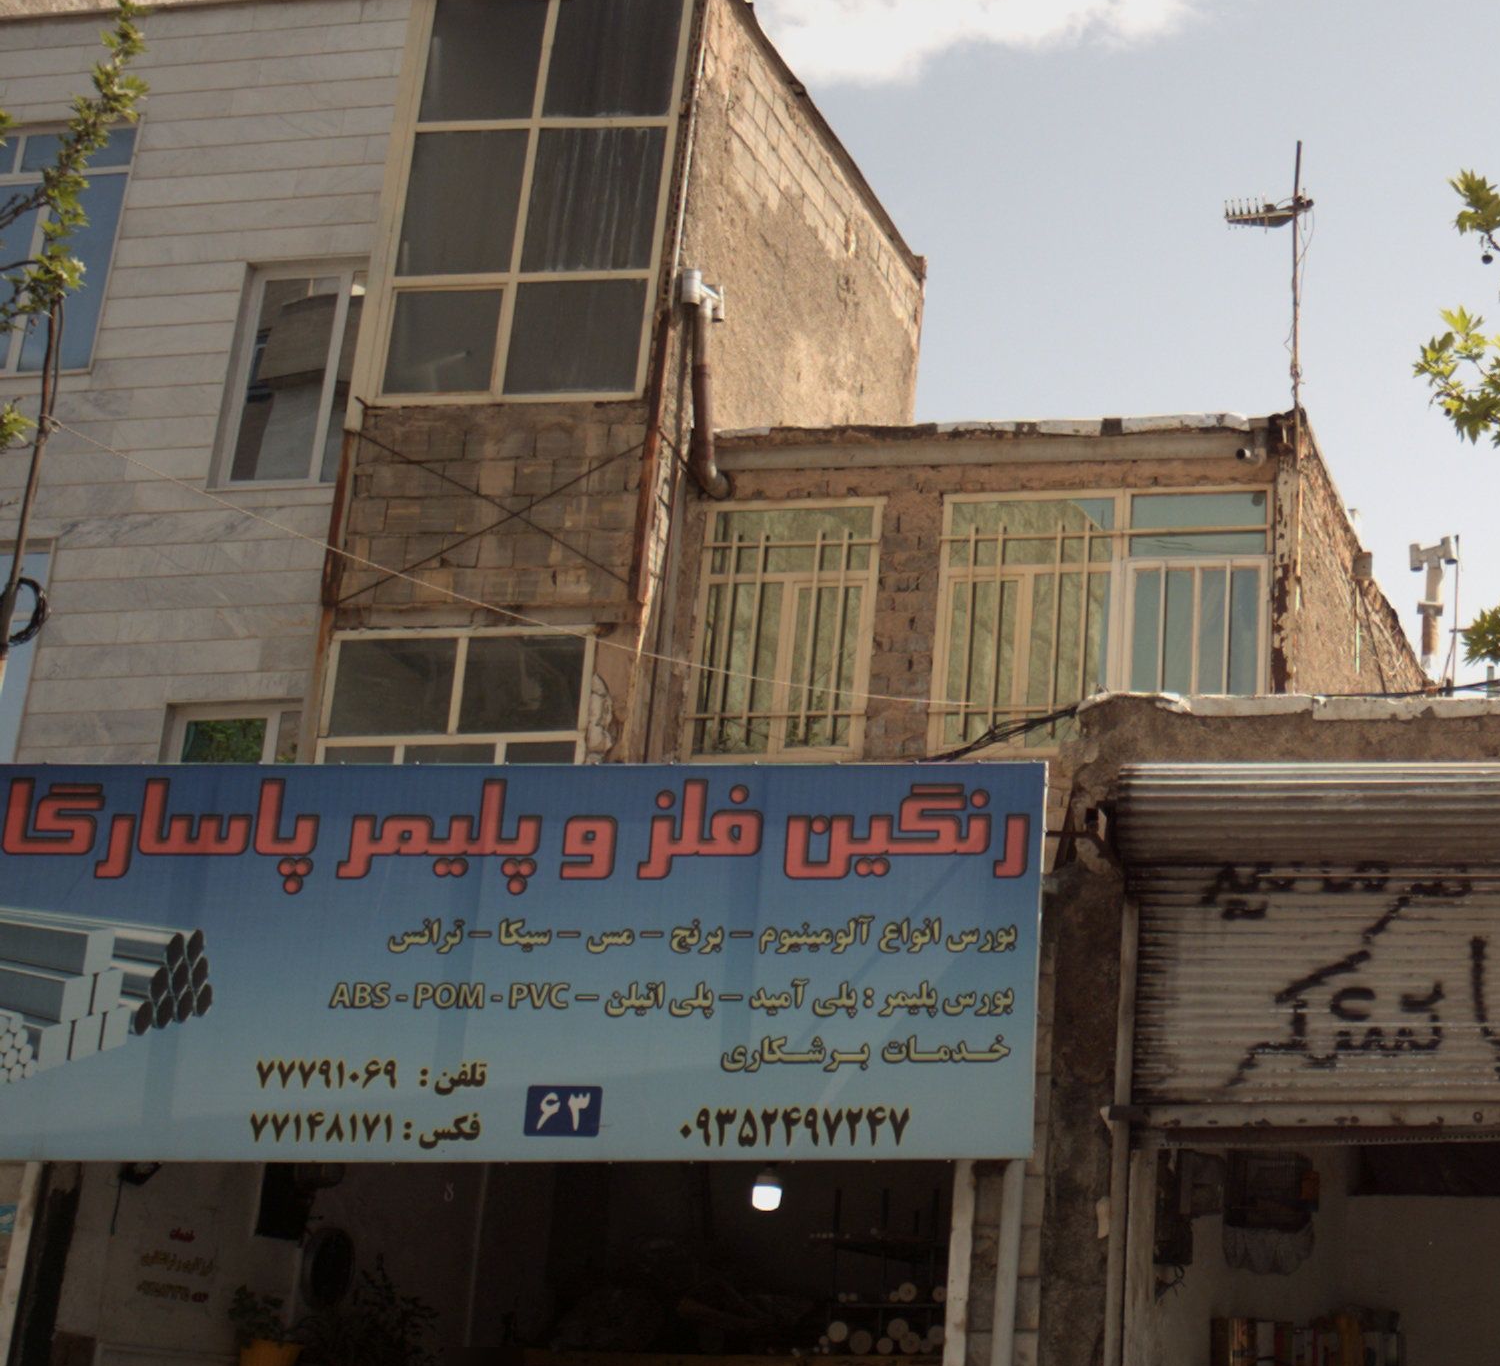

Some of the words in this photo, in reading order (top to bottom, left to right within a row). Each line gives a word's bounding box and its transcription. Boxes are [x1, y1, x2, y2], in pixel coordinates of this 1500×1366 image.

[336, 778, 543, 895] پلیمر
[637, 778, 764, 880] فلز
[783, 783, 1031, 880] رنگین
[559, 815, 619, 880] و
[388, 919, 464, 954] ترانس
[498, 919, 550, 953] سیکا
[586, 927, 634, 954] مس
[671, 921, 725, 955] برنج
[759, 915, 875, 953] آلومینیوم
[878, 917, 942, 953] انواع
[946, 921, 1018, 953] بورس
[329, 983, 390, 1009] ABS
[413, 983, 486, 1009] POM
[509, 983, 570, 1009] PVC
[605, 982, 666, 1017] اتیلن
[668, 982, 714, 1018] پلی
[748, 979, 809, 1016] آمید
[812, 982, 858, 1018] پلی
[942, 982, 1014, 1016] بورس
[721, 1037, 871, 1073] برشکاری
[881, 1035, 1011, 1064] خدمات
[255, 1059, 398, 1089] ۷۷۷۹۱۰۶۹
[249, 1112, 394, 1143] ۷۷۱۴۸۱۷۱
[536, 1090, 591, 1131] ۶۳
[680, 1106, 911, 1148] ۰۹۳۵۲۴۹۷۲۴۷
